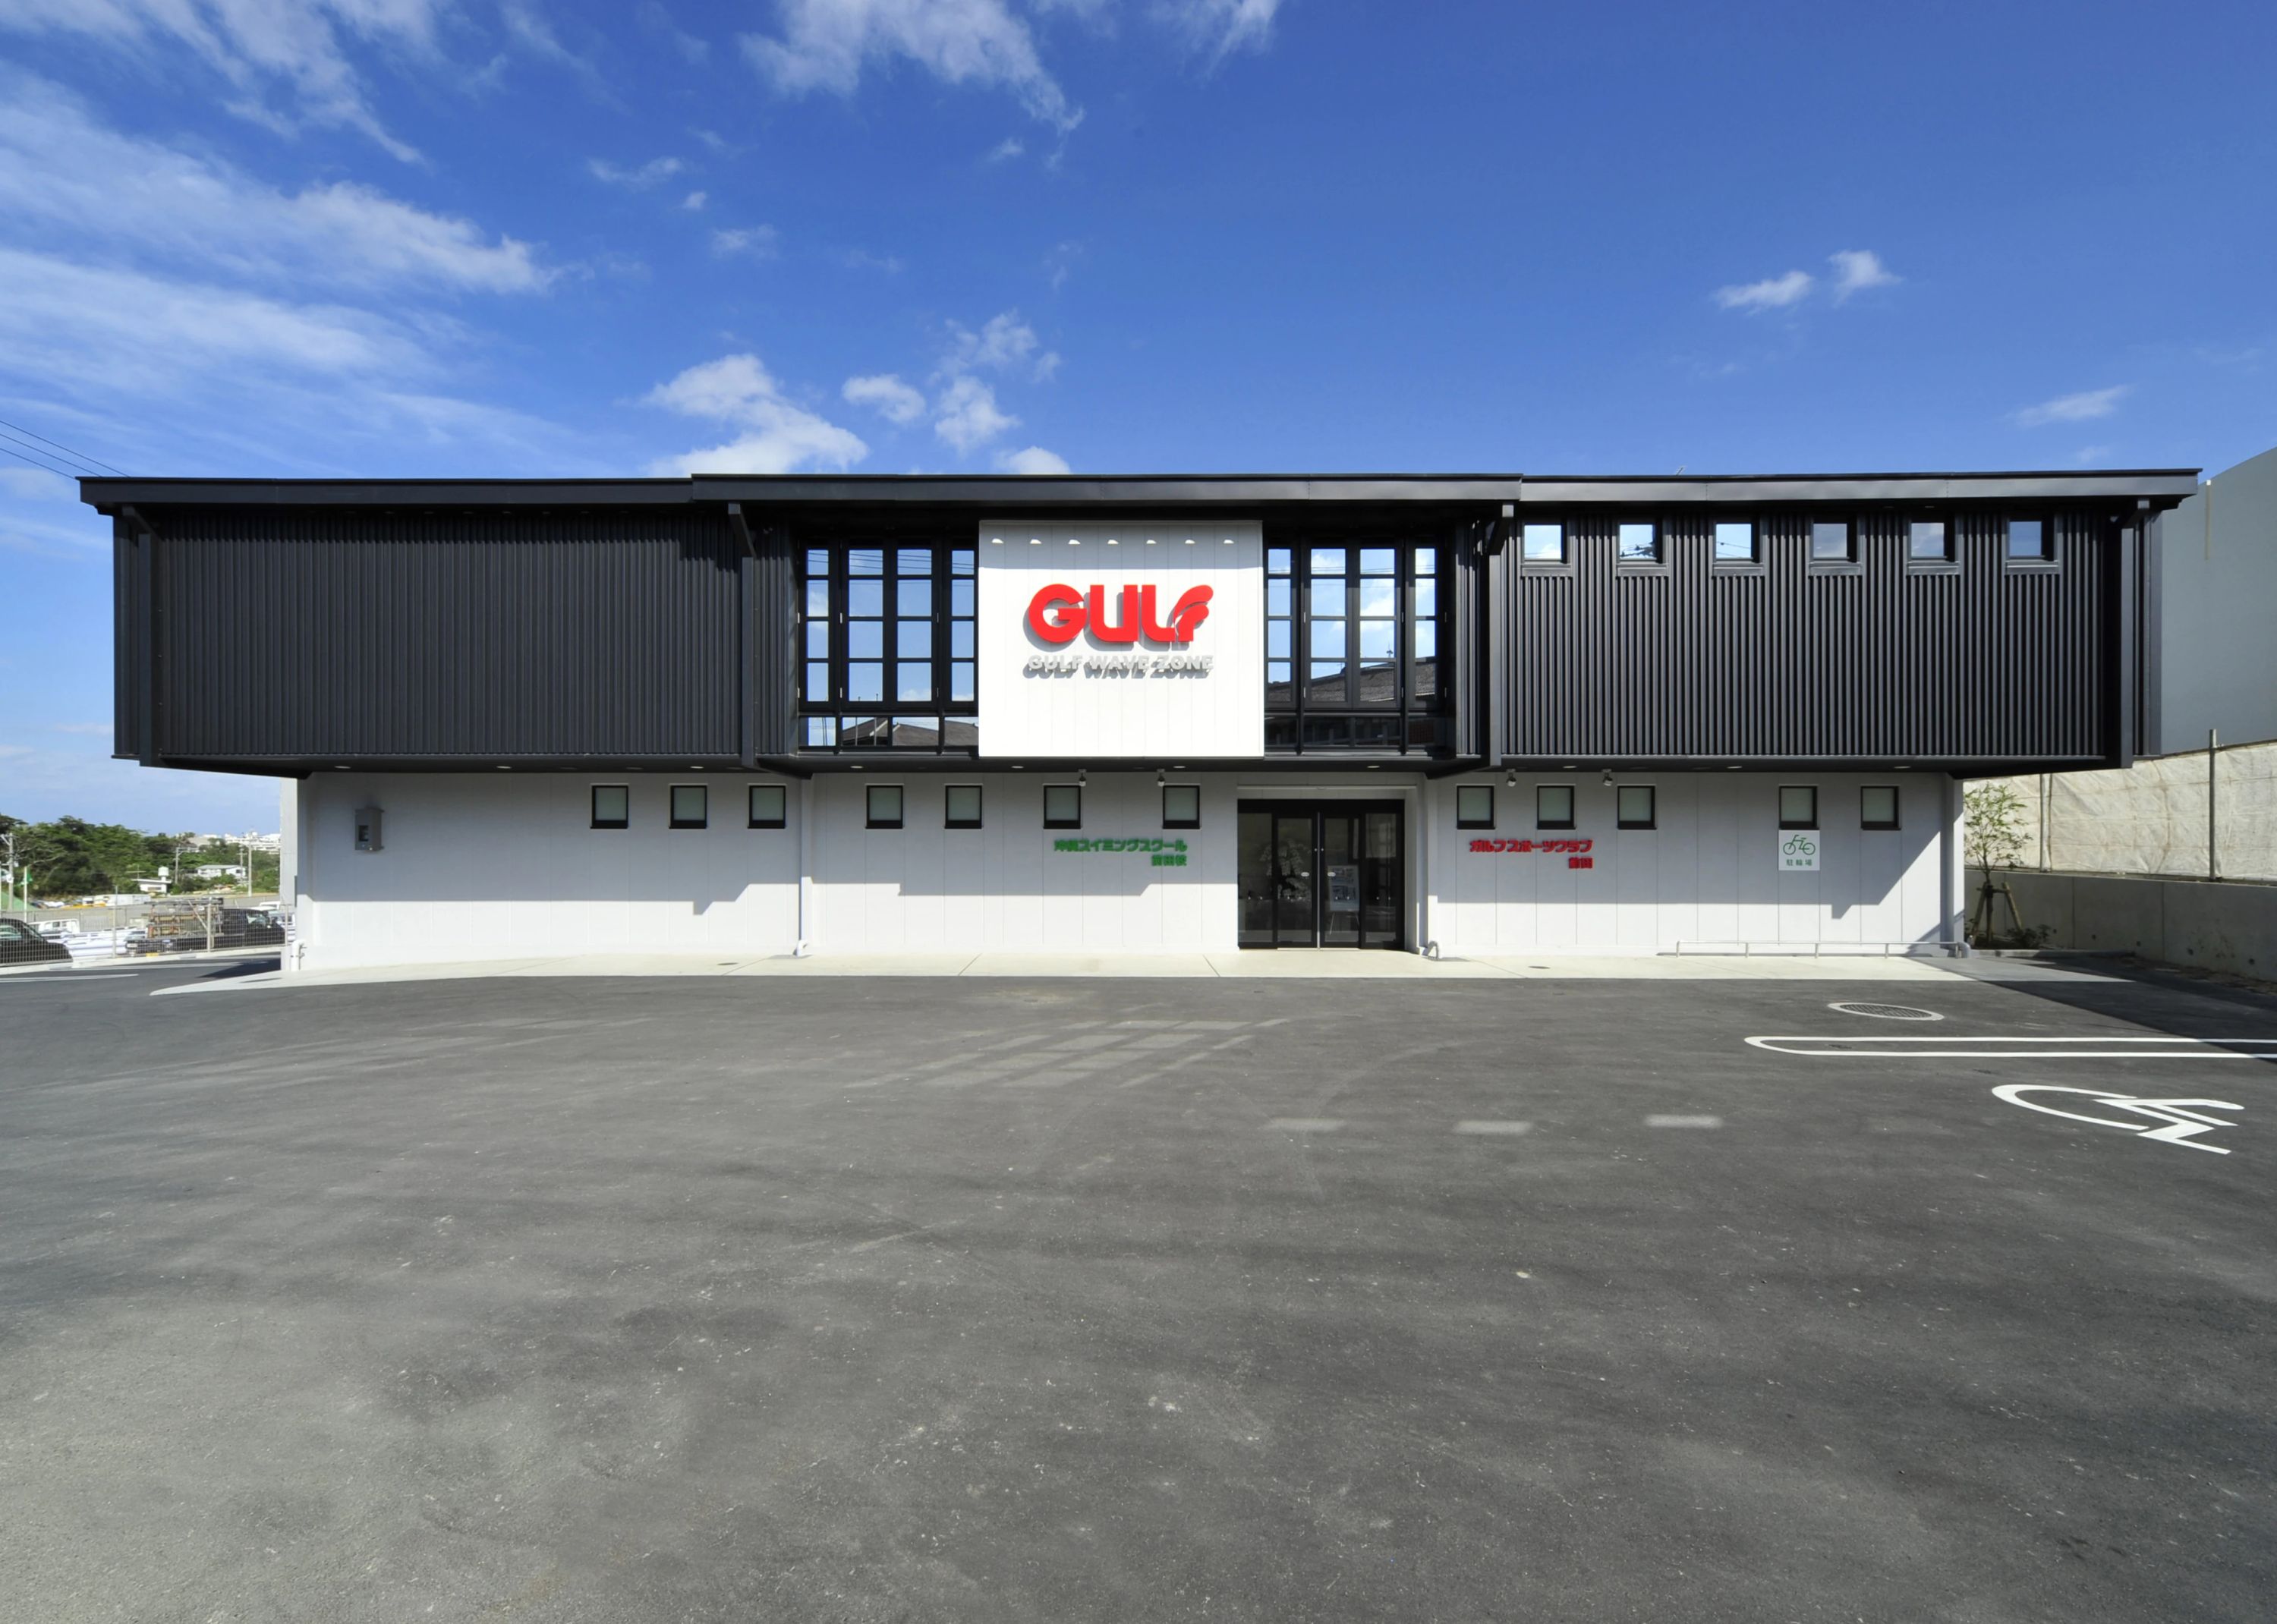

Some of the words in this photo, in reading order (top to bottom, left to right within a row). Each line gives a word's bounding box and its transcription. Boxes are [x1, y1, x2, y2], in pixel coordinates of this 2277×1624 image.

[1028, 584, 1214, 643] GULF
[1028, 655, 1082, 669] GULF
[1089, 655, 1150, 669] WAVE
[1157, 655, 1214, 669] ZONE
